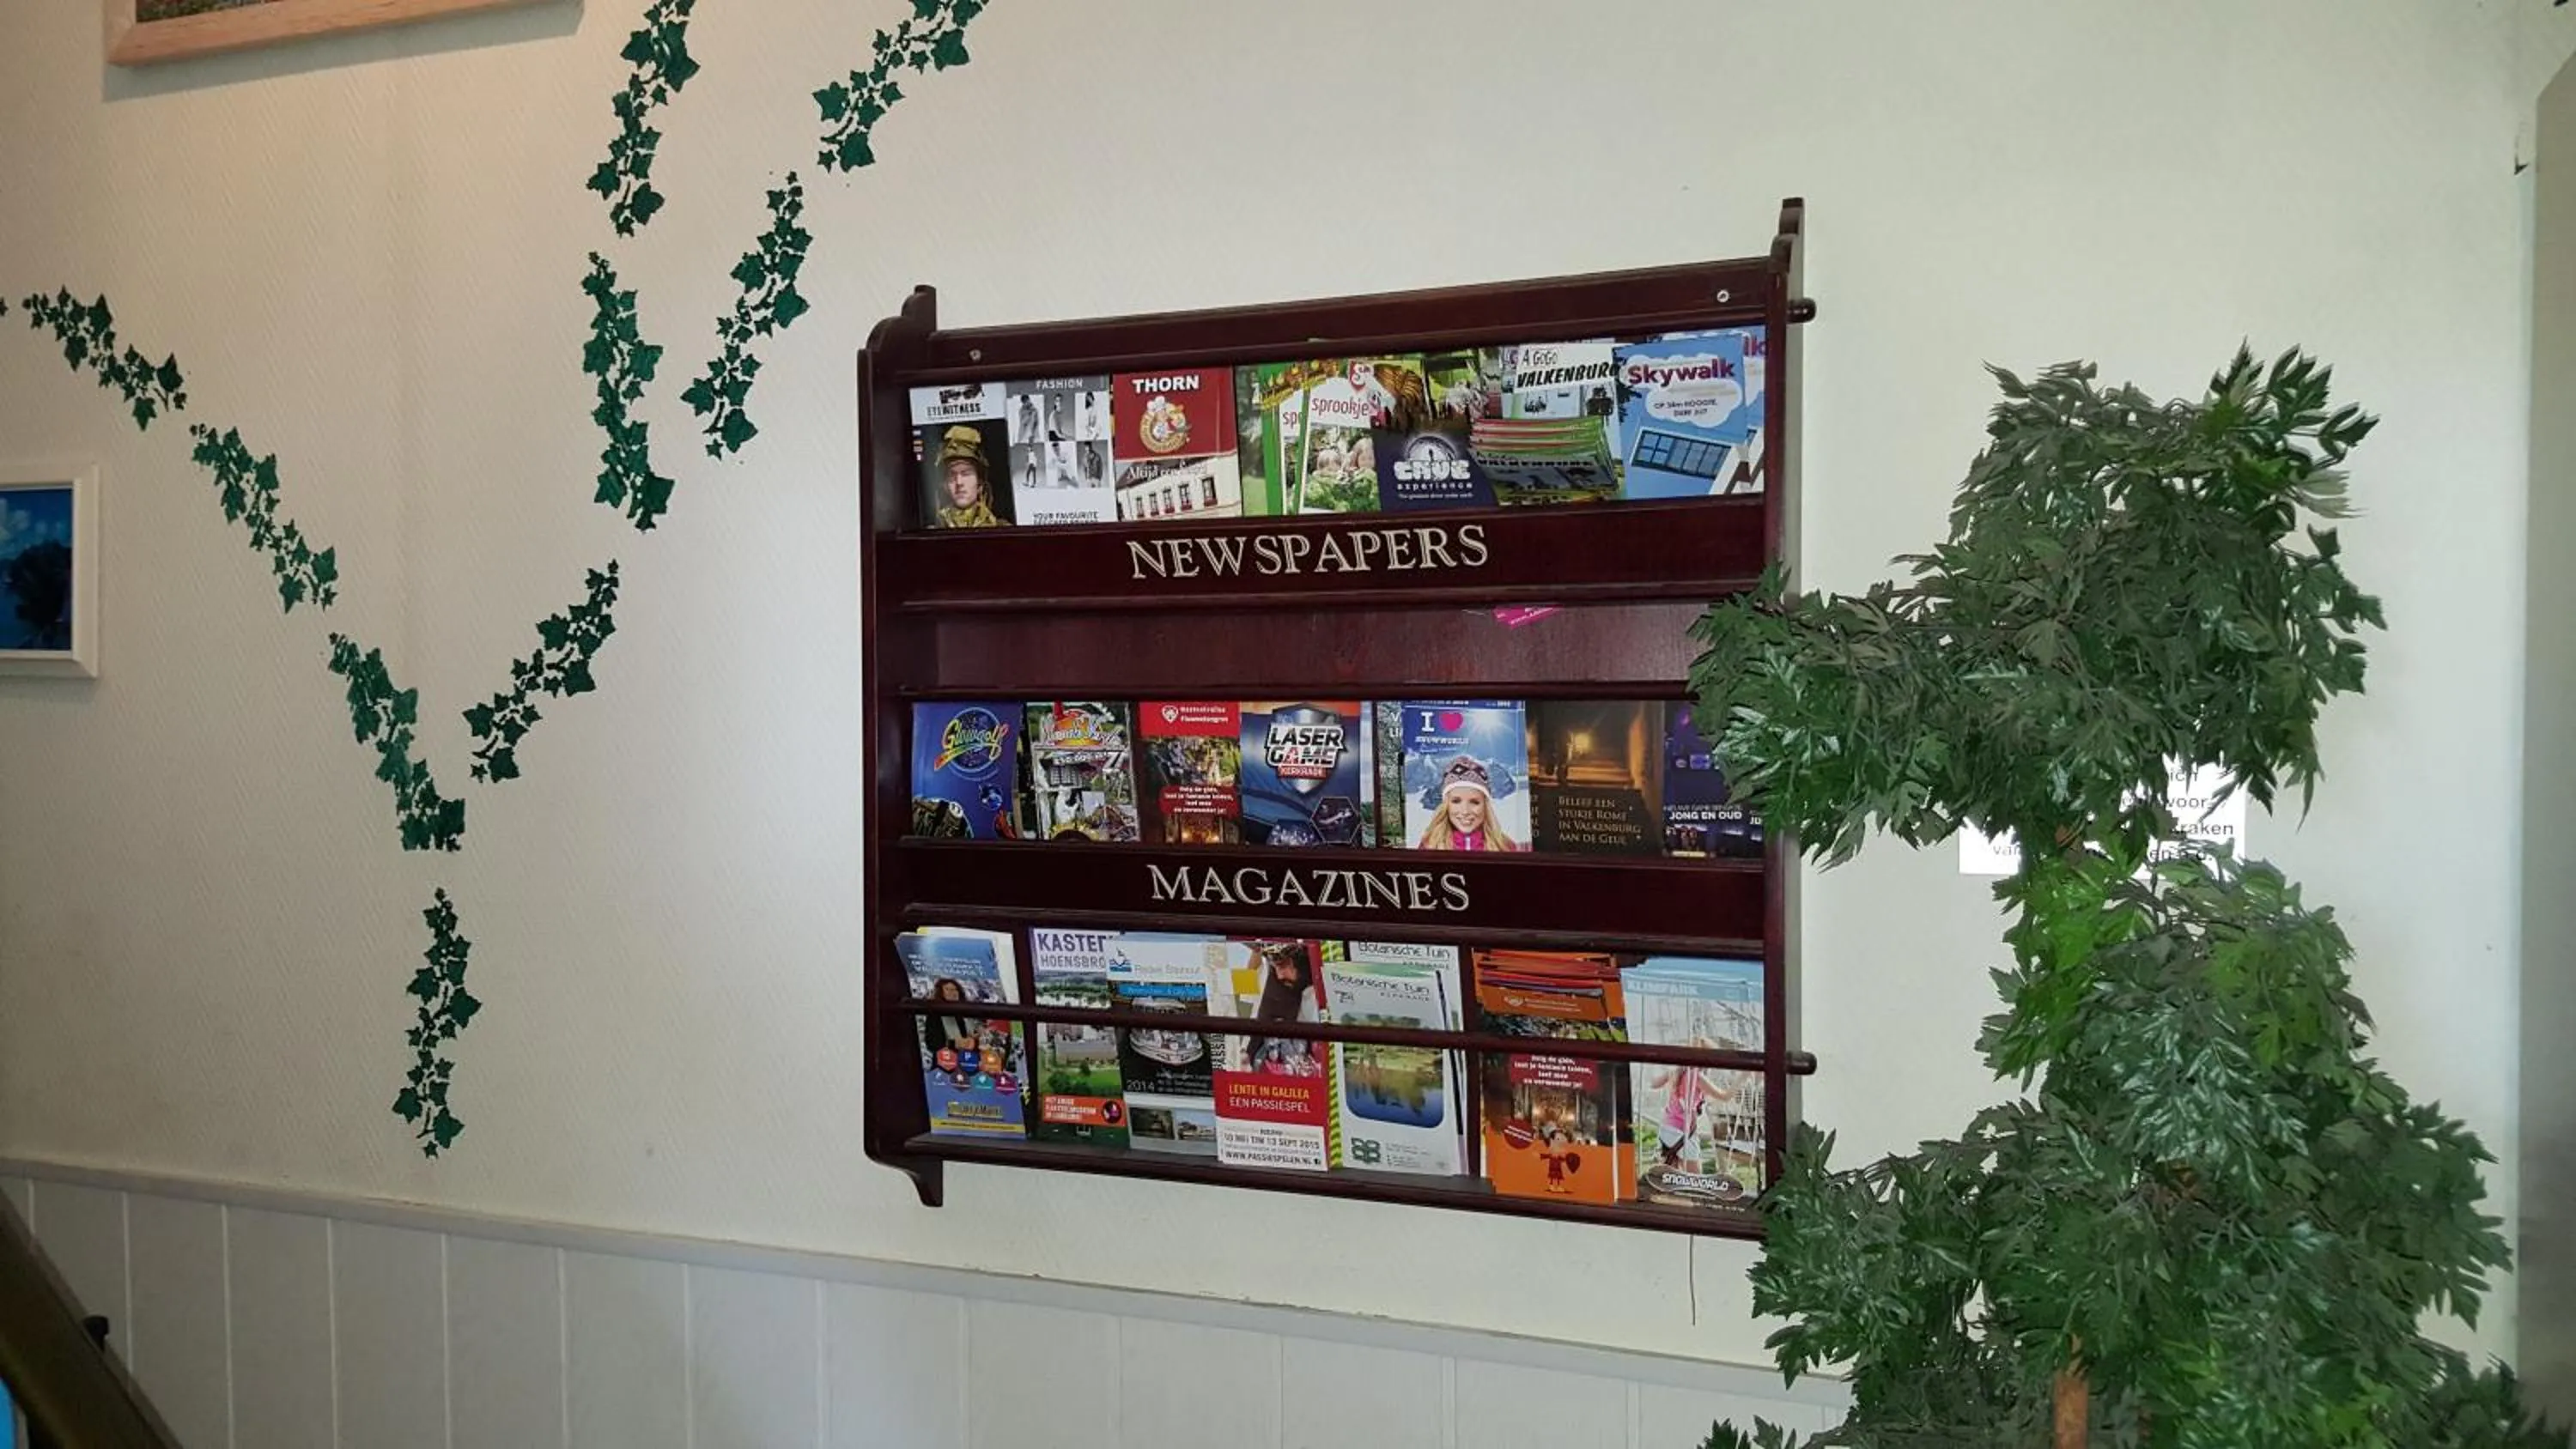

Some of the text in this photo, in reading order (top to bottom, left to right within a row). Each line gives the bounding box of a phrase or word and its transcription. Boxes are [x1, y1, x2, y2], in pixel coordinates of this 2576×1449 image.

[1626, 358, 1736, 386] Skywalk
[1036, 378, 1083, 389] FASHION
[1132, 375, 1199, 393] THORN
[1127, 524, 1489, 579] NEWSPAPERS
[1420, 712, 1435, 732] I
[1270, 727, 1342, 747] LASER
[1270, 746, 1335, 766] GAME
[1669, 811, 1742, 820] JONG EN OUD
[1147, 864, 1470, 911] MAGAZINES
[1127, 1079, 1156, 1093] 2014
[1229, 1084, 1309, 1099] LENTE IN GALILEA
[1229, 1097, 1310, 1113] EEN PASSIESPEL
